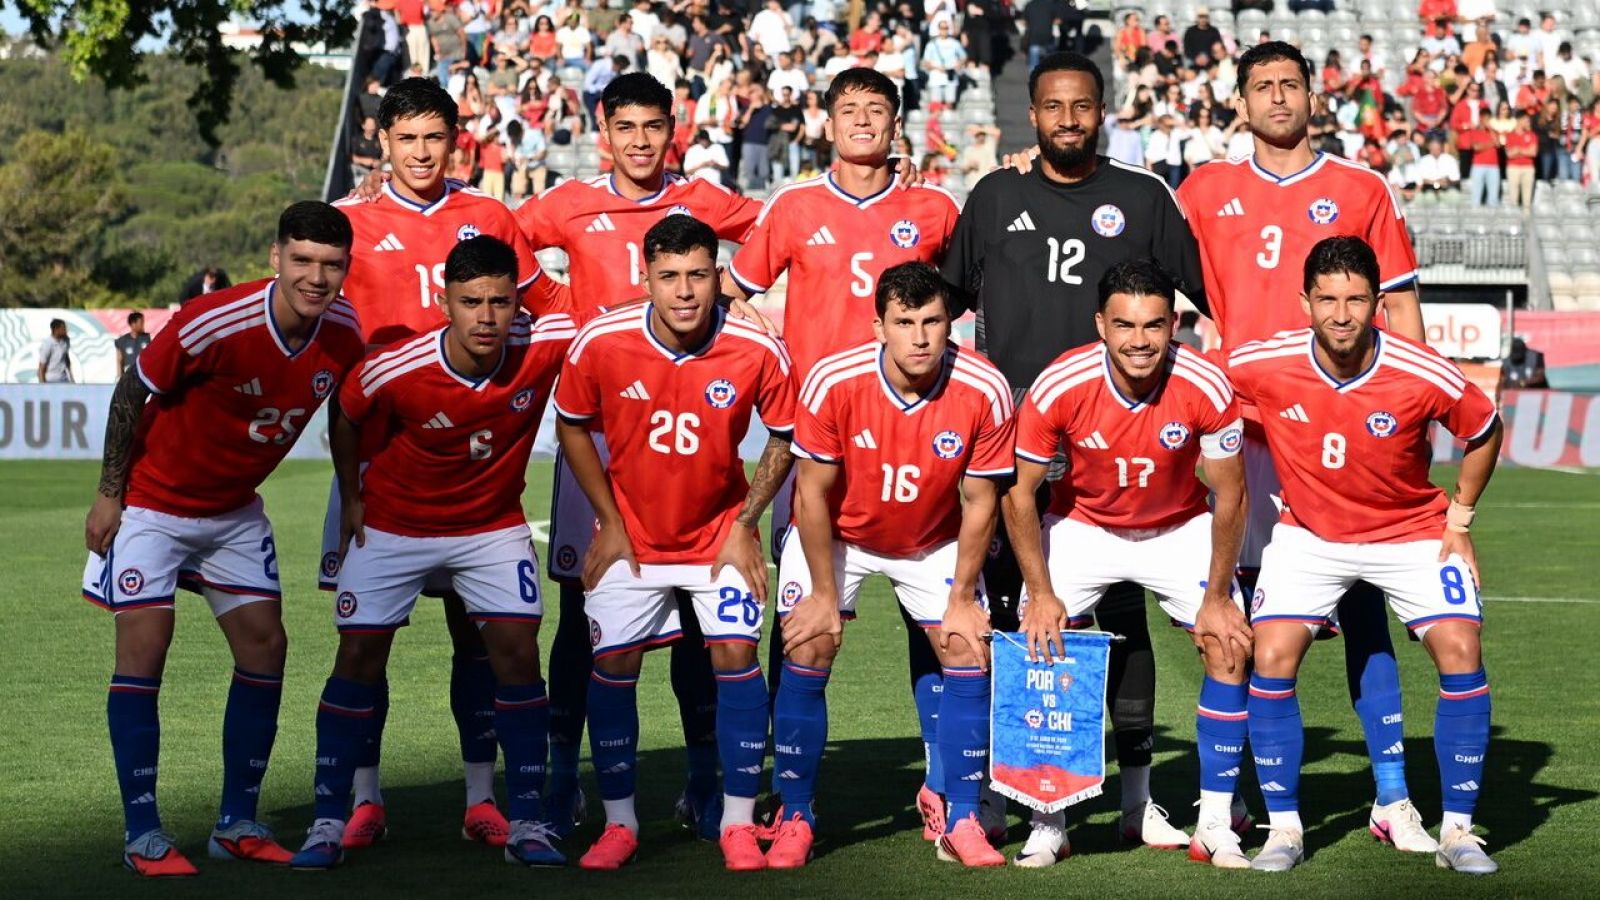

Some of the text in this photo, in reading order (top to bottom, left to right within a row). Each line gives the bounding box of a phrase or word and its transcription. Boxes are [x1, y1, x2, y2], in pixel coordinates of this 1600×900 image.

[1047, 237, 1086, 285] 12
[1256, 225, 1283, 269] 3
[850, 252, 874, 297] 5
[248, 407, 305, 445] 25
[650, 410, 700, 455] 26
[470, 432, 494, 460] 6
[1321, 432, 1346, 469] 8
[881, 463, 921, 502] 16
[1114, 457, 1155, 488] 17
[516, 559, 538, 604] 6
[1440, 565, 1467, 605] 8
[717, 586, 760, 627] 26
[1026, 669, 1054, 691] POR
[1043, 694, 1056, 708] VS
[1048, 713, 1073, 731] CHI
[1253, 756, 1283, 766] CHILE
